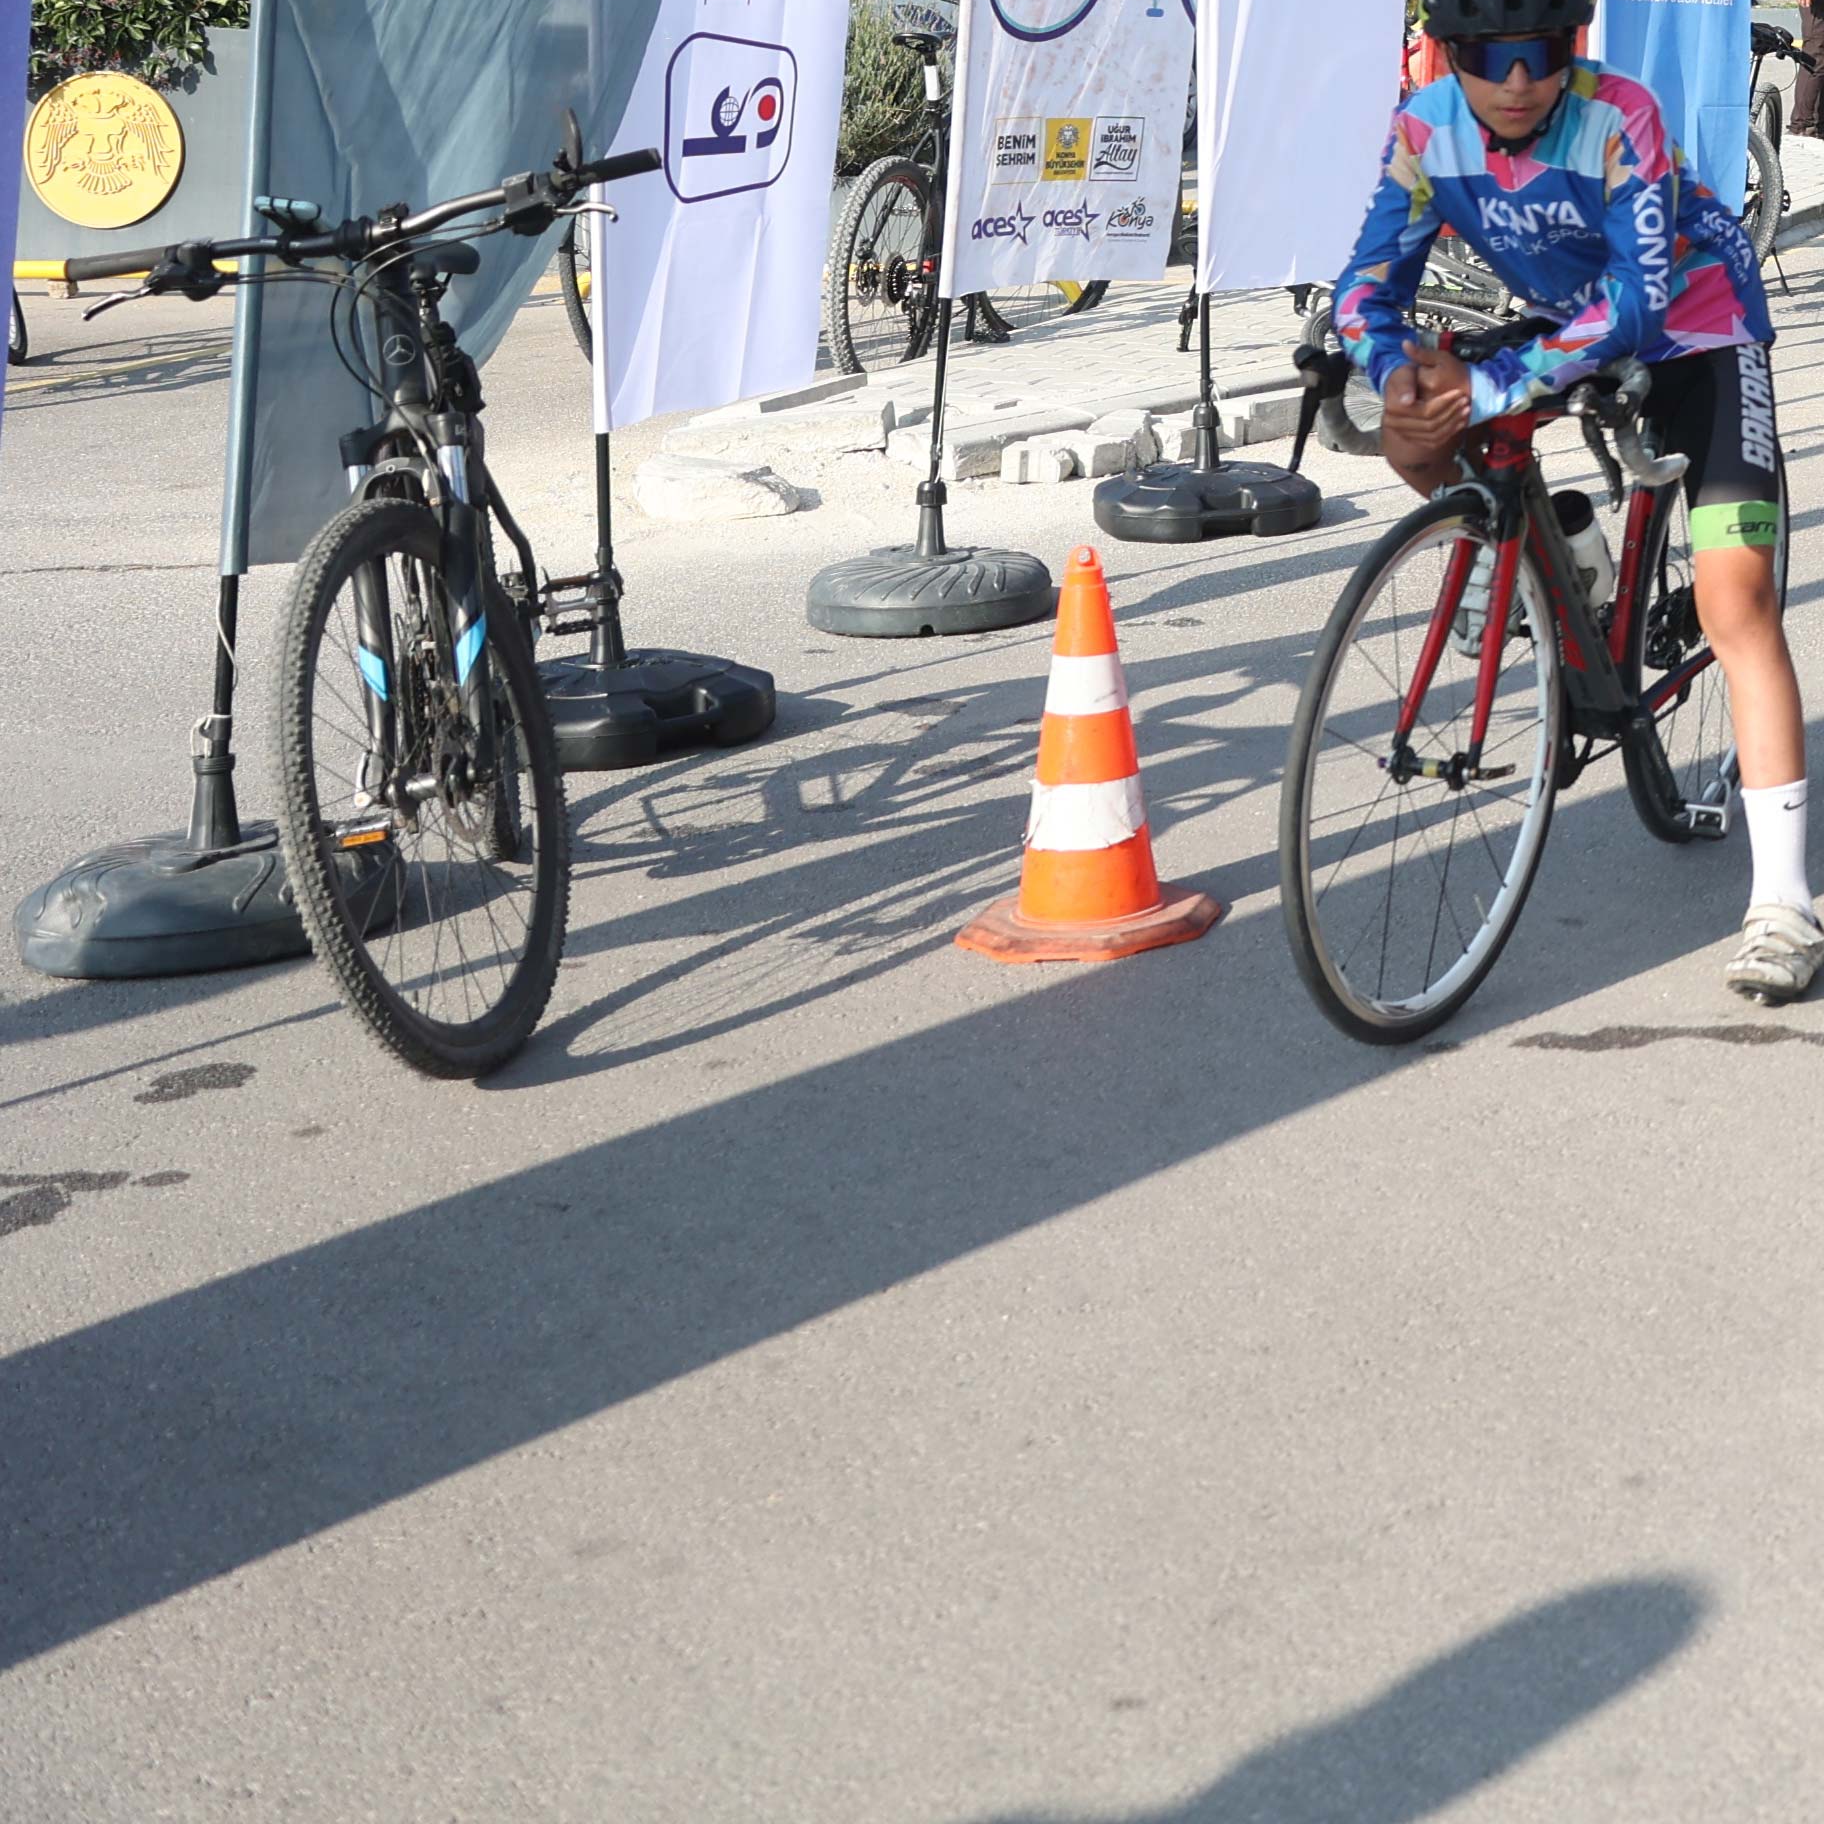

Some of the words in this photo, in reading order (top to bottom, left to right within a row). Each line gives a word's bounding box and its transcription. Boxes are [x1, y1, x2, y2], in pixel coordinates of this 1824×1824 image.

[971, 216, 1016, 240] aces
[1042, 208, 1082, 227] aces
[1632, 182, 1669, 312] KONYA
